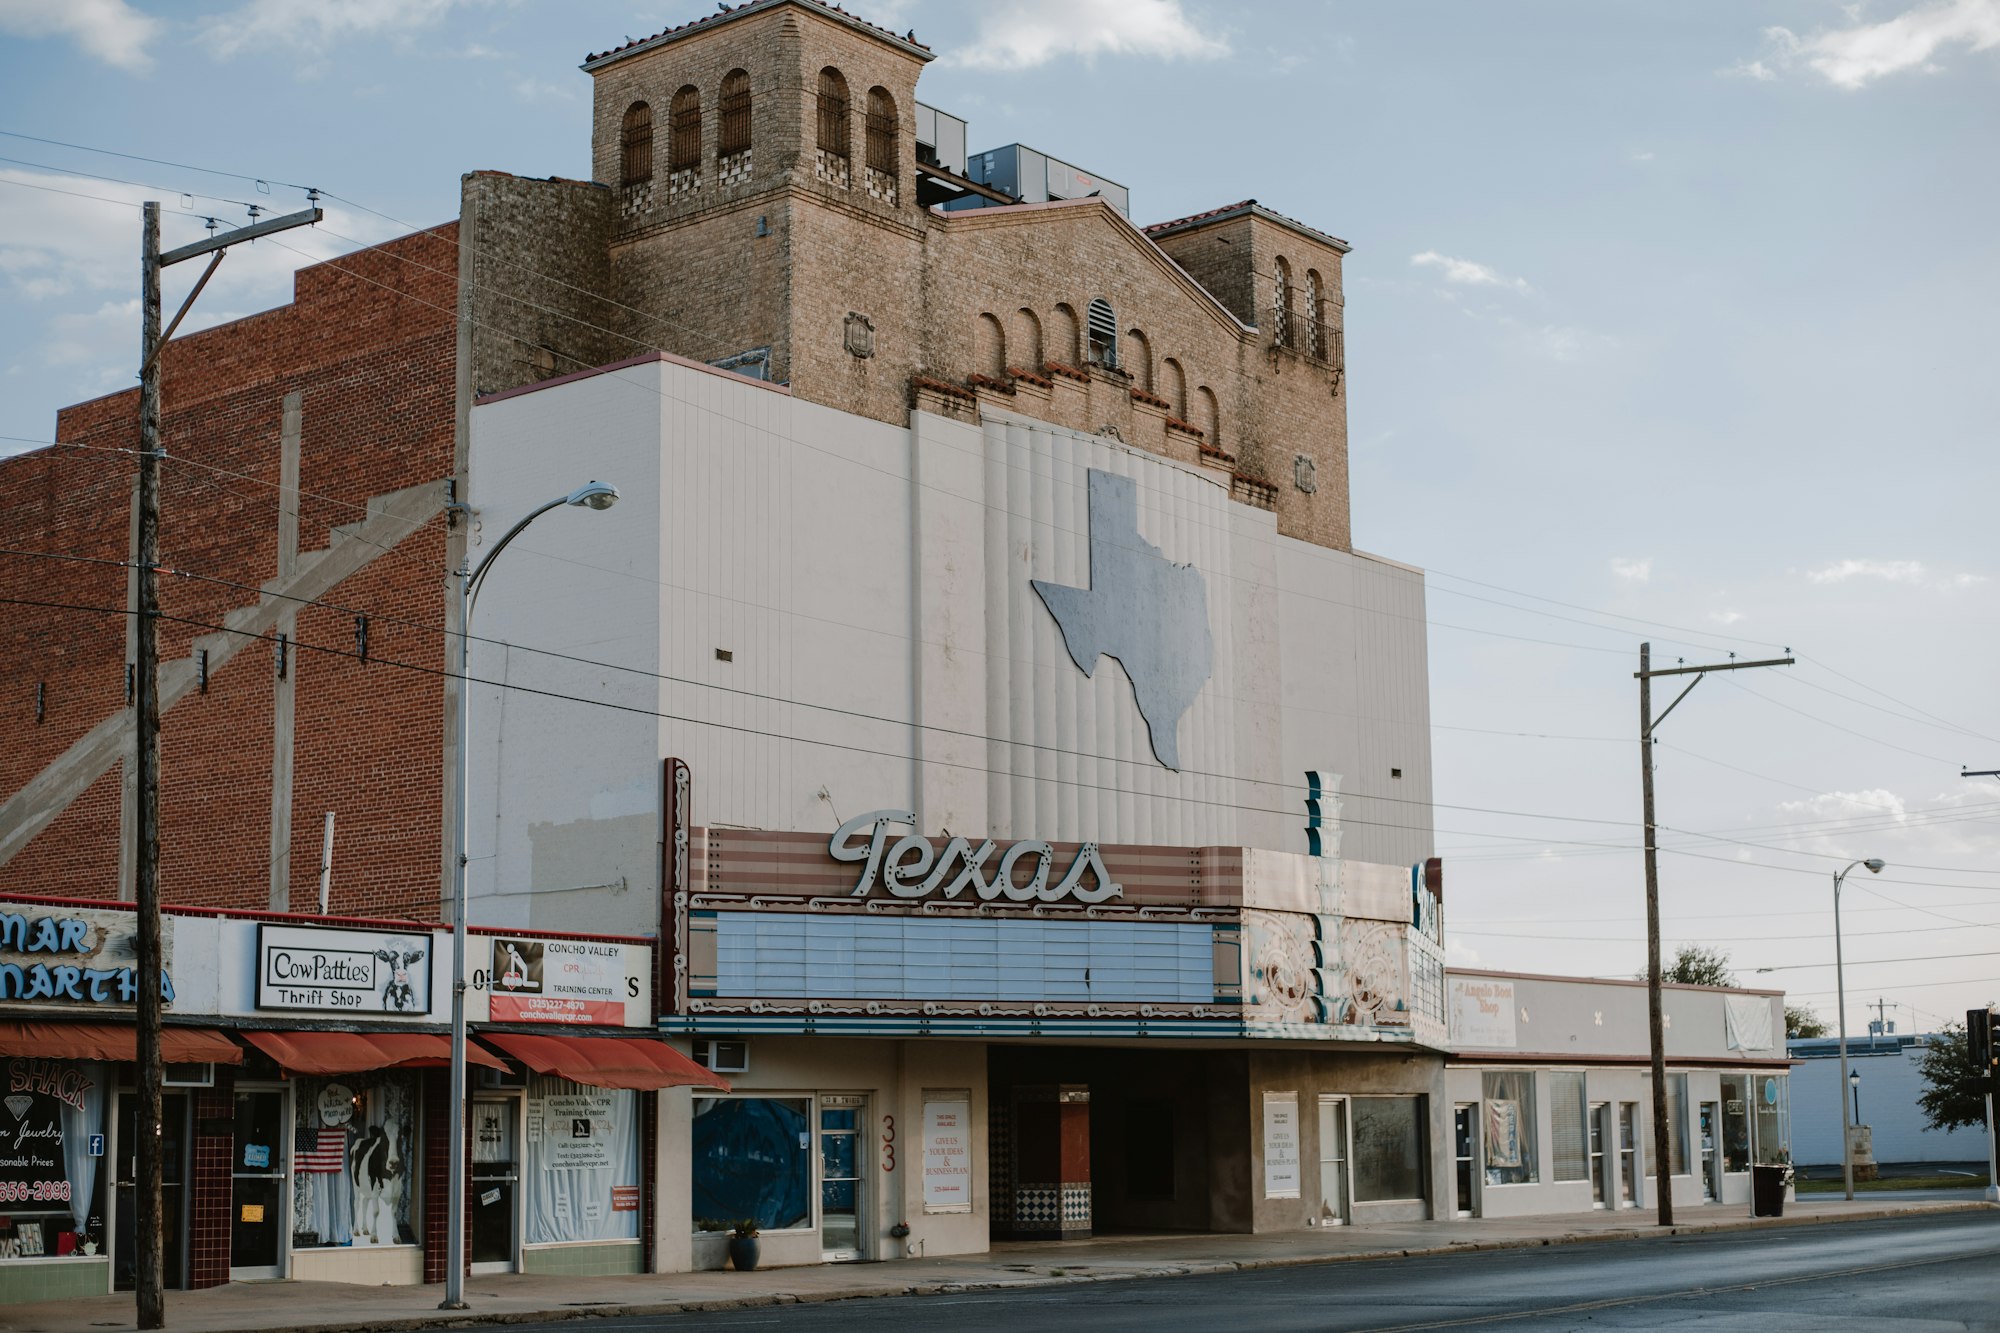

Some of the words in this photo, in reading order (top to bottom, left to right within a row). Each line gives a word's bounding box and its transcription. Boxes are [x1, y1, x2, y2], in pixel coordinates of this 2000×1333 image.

[829, 809, 1124, 903] Texas
[548, 943, 586, 955] CONCHO
[588, 945, 620, 957] VALLEY
[563, 963, 580, 974] CPR
[553, 984, 587, 994] TRAINING
[588, 986, 613, 996] CENTER
[1464, 983, 1493, 1000] Angelo
[278, 989, 324, 1005] Thrift
[331, 990, 362, 1008] Shop
[528, 999, 585, 1011] (325)227-4870
[1479, 1000, 1499, 1017] Shop
[519, 1010, 593, 1023] conchovalleycpr.com
[9, 1058, 95, 1112] SHACK
[549, 1098, 575, 1107] Concho
[596, 1098, 611, 1106] CPR
[554, 1108, 584, 1117] Training
[13, 1120, 65, 1150] Jewelry
[935, 1137, 951, 1145] GIVE
[951, 1137, 958, 1145] US
[929, 1147, 946, 1155] YOUR
[946, 1147, 964, 1155] IDEAS
[31, 1155, 54, 1167] Prices
[943, 1156, 951, 1167] &
[925, 1167, 952, 1175] BUSINESS
[952, 1167, 968, 1175] PLAN
